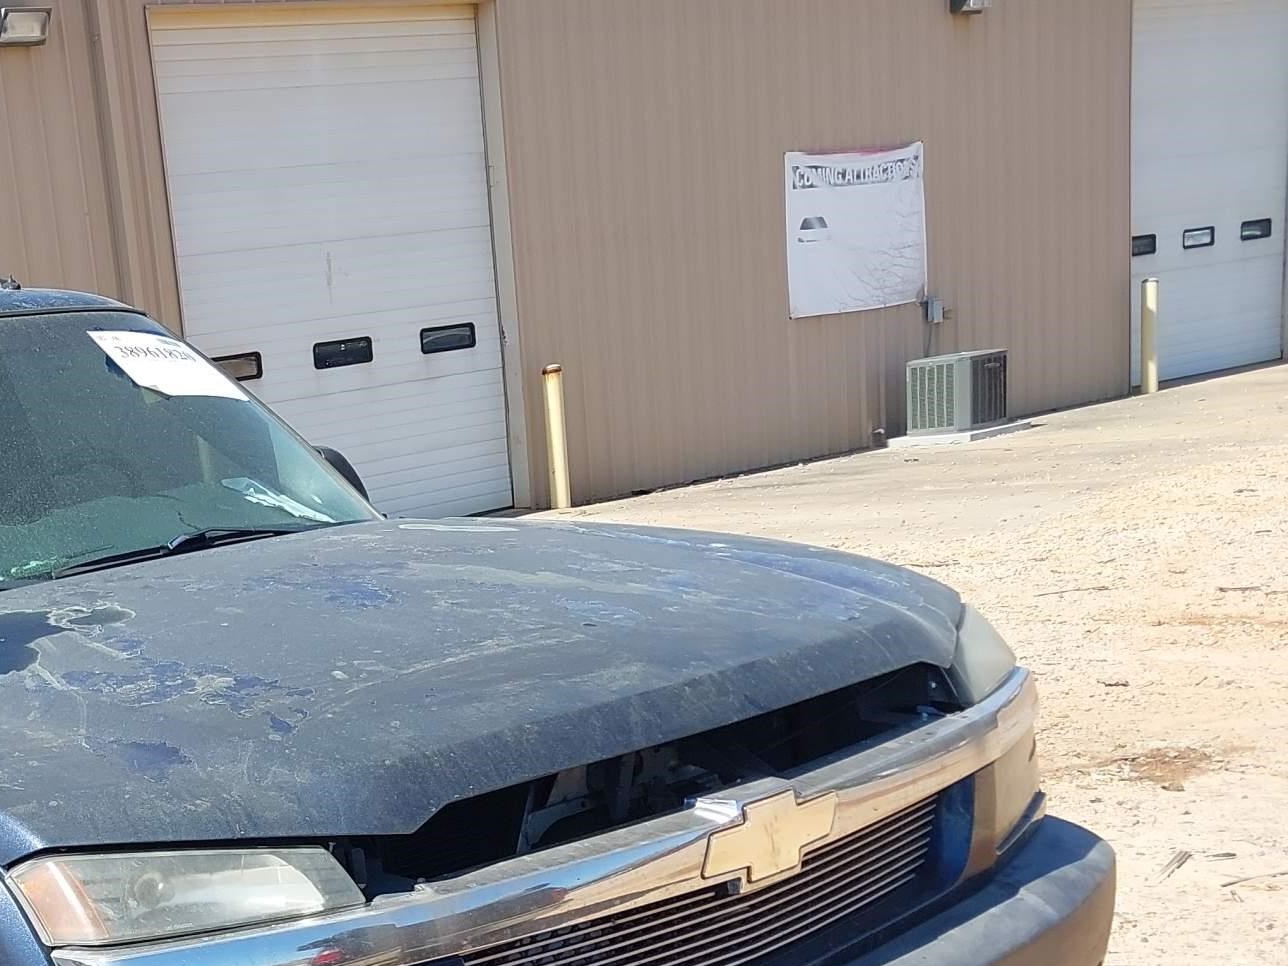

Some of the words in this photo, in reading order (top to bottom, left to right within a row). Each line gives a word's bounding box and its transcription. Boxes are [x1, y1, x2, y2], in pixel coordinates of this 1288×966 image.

[795, 166, 843, 187] COMING
[845, 157, 919, 184] ATTRACTIONS
[114, 345, 197, 363] 38961820
